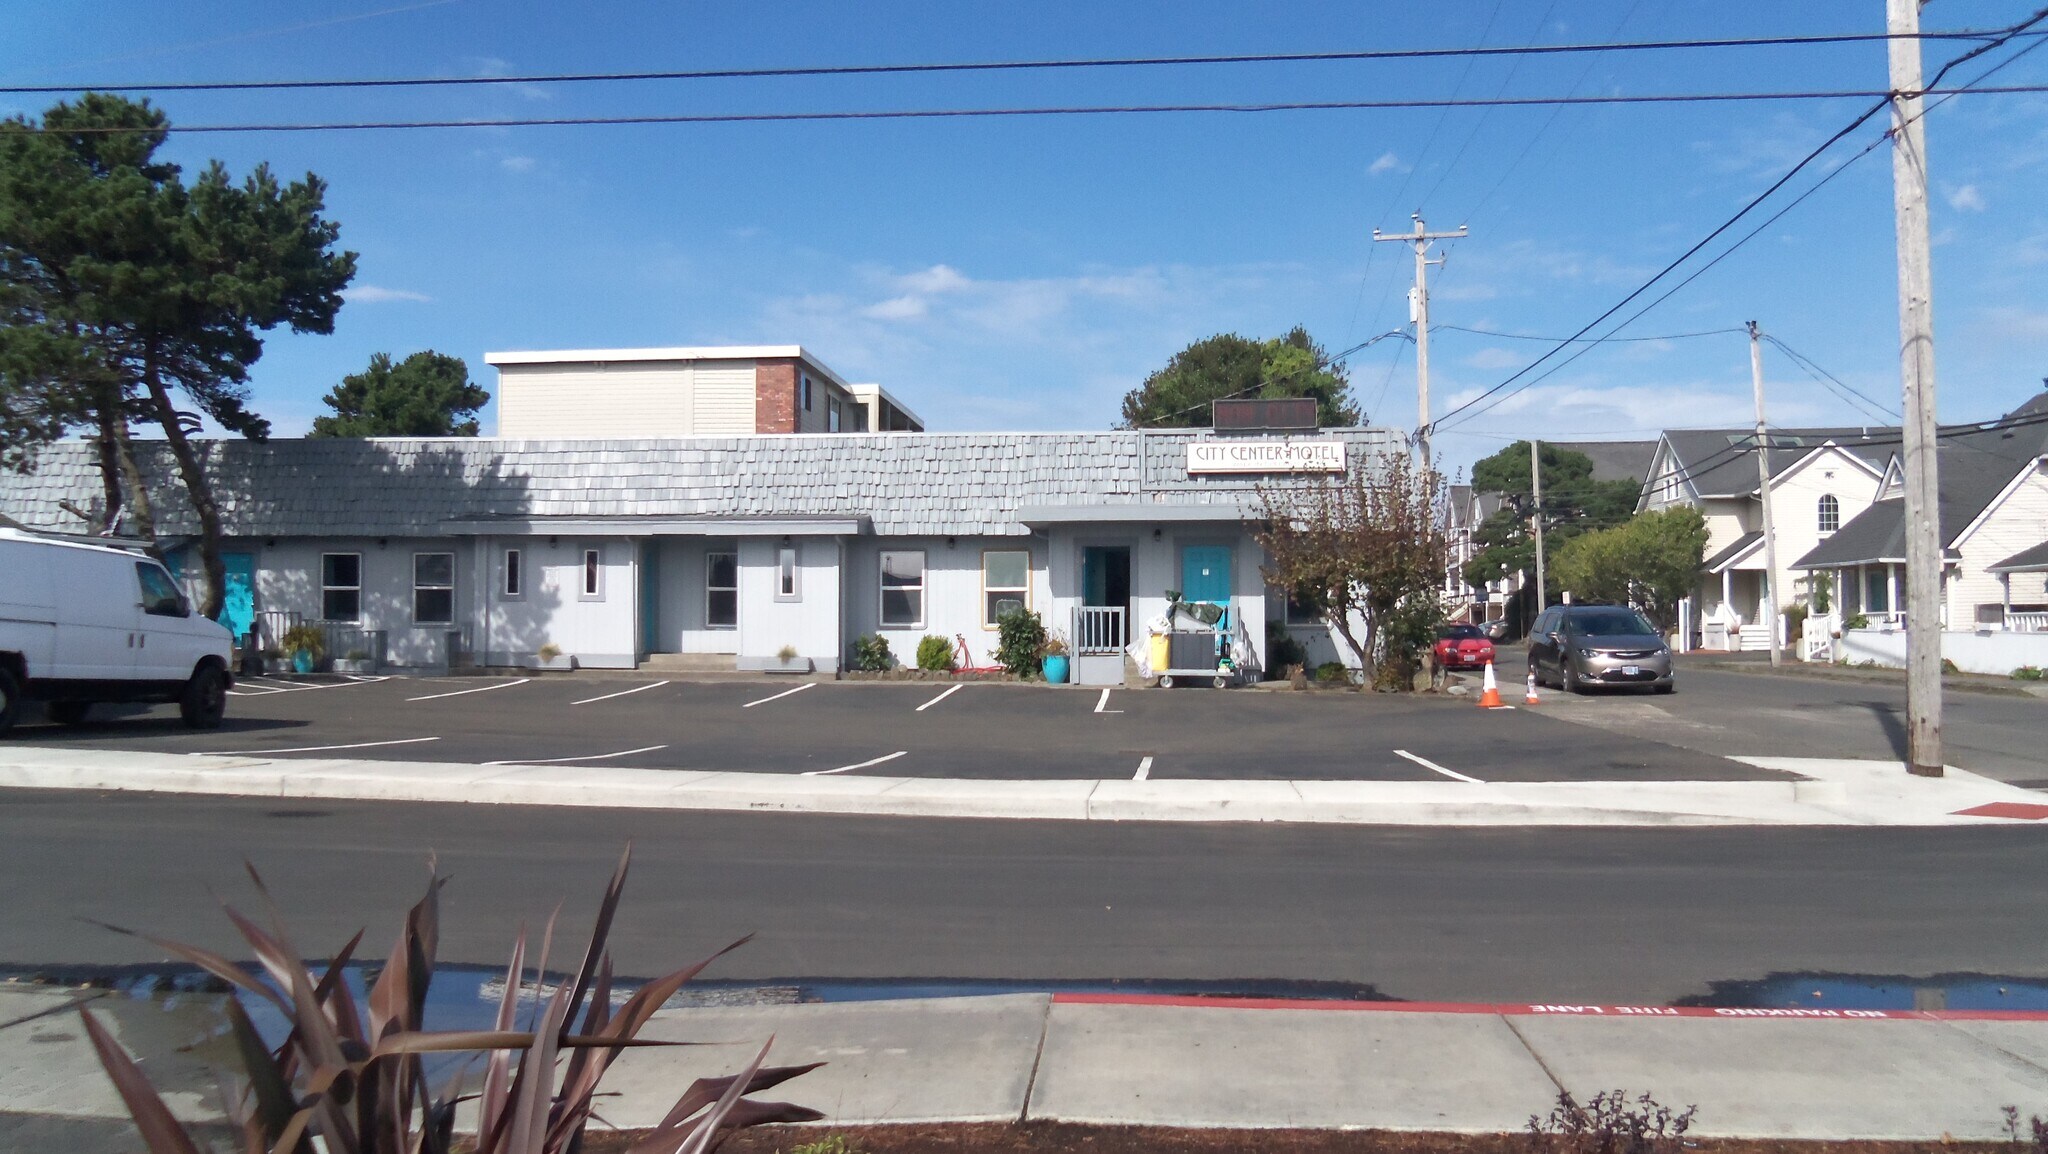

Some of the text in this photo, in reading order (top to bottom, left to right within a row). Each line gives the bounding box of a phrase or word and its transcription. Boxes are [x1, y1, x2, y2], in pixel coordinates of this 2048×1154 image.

[1196, 445, 1339, 460] CITY CENTER MOTEL
[1529, 1005, 1605, 1013] LANE
[1714, 1008, 1840, 1017] PARKING
